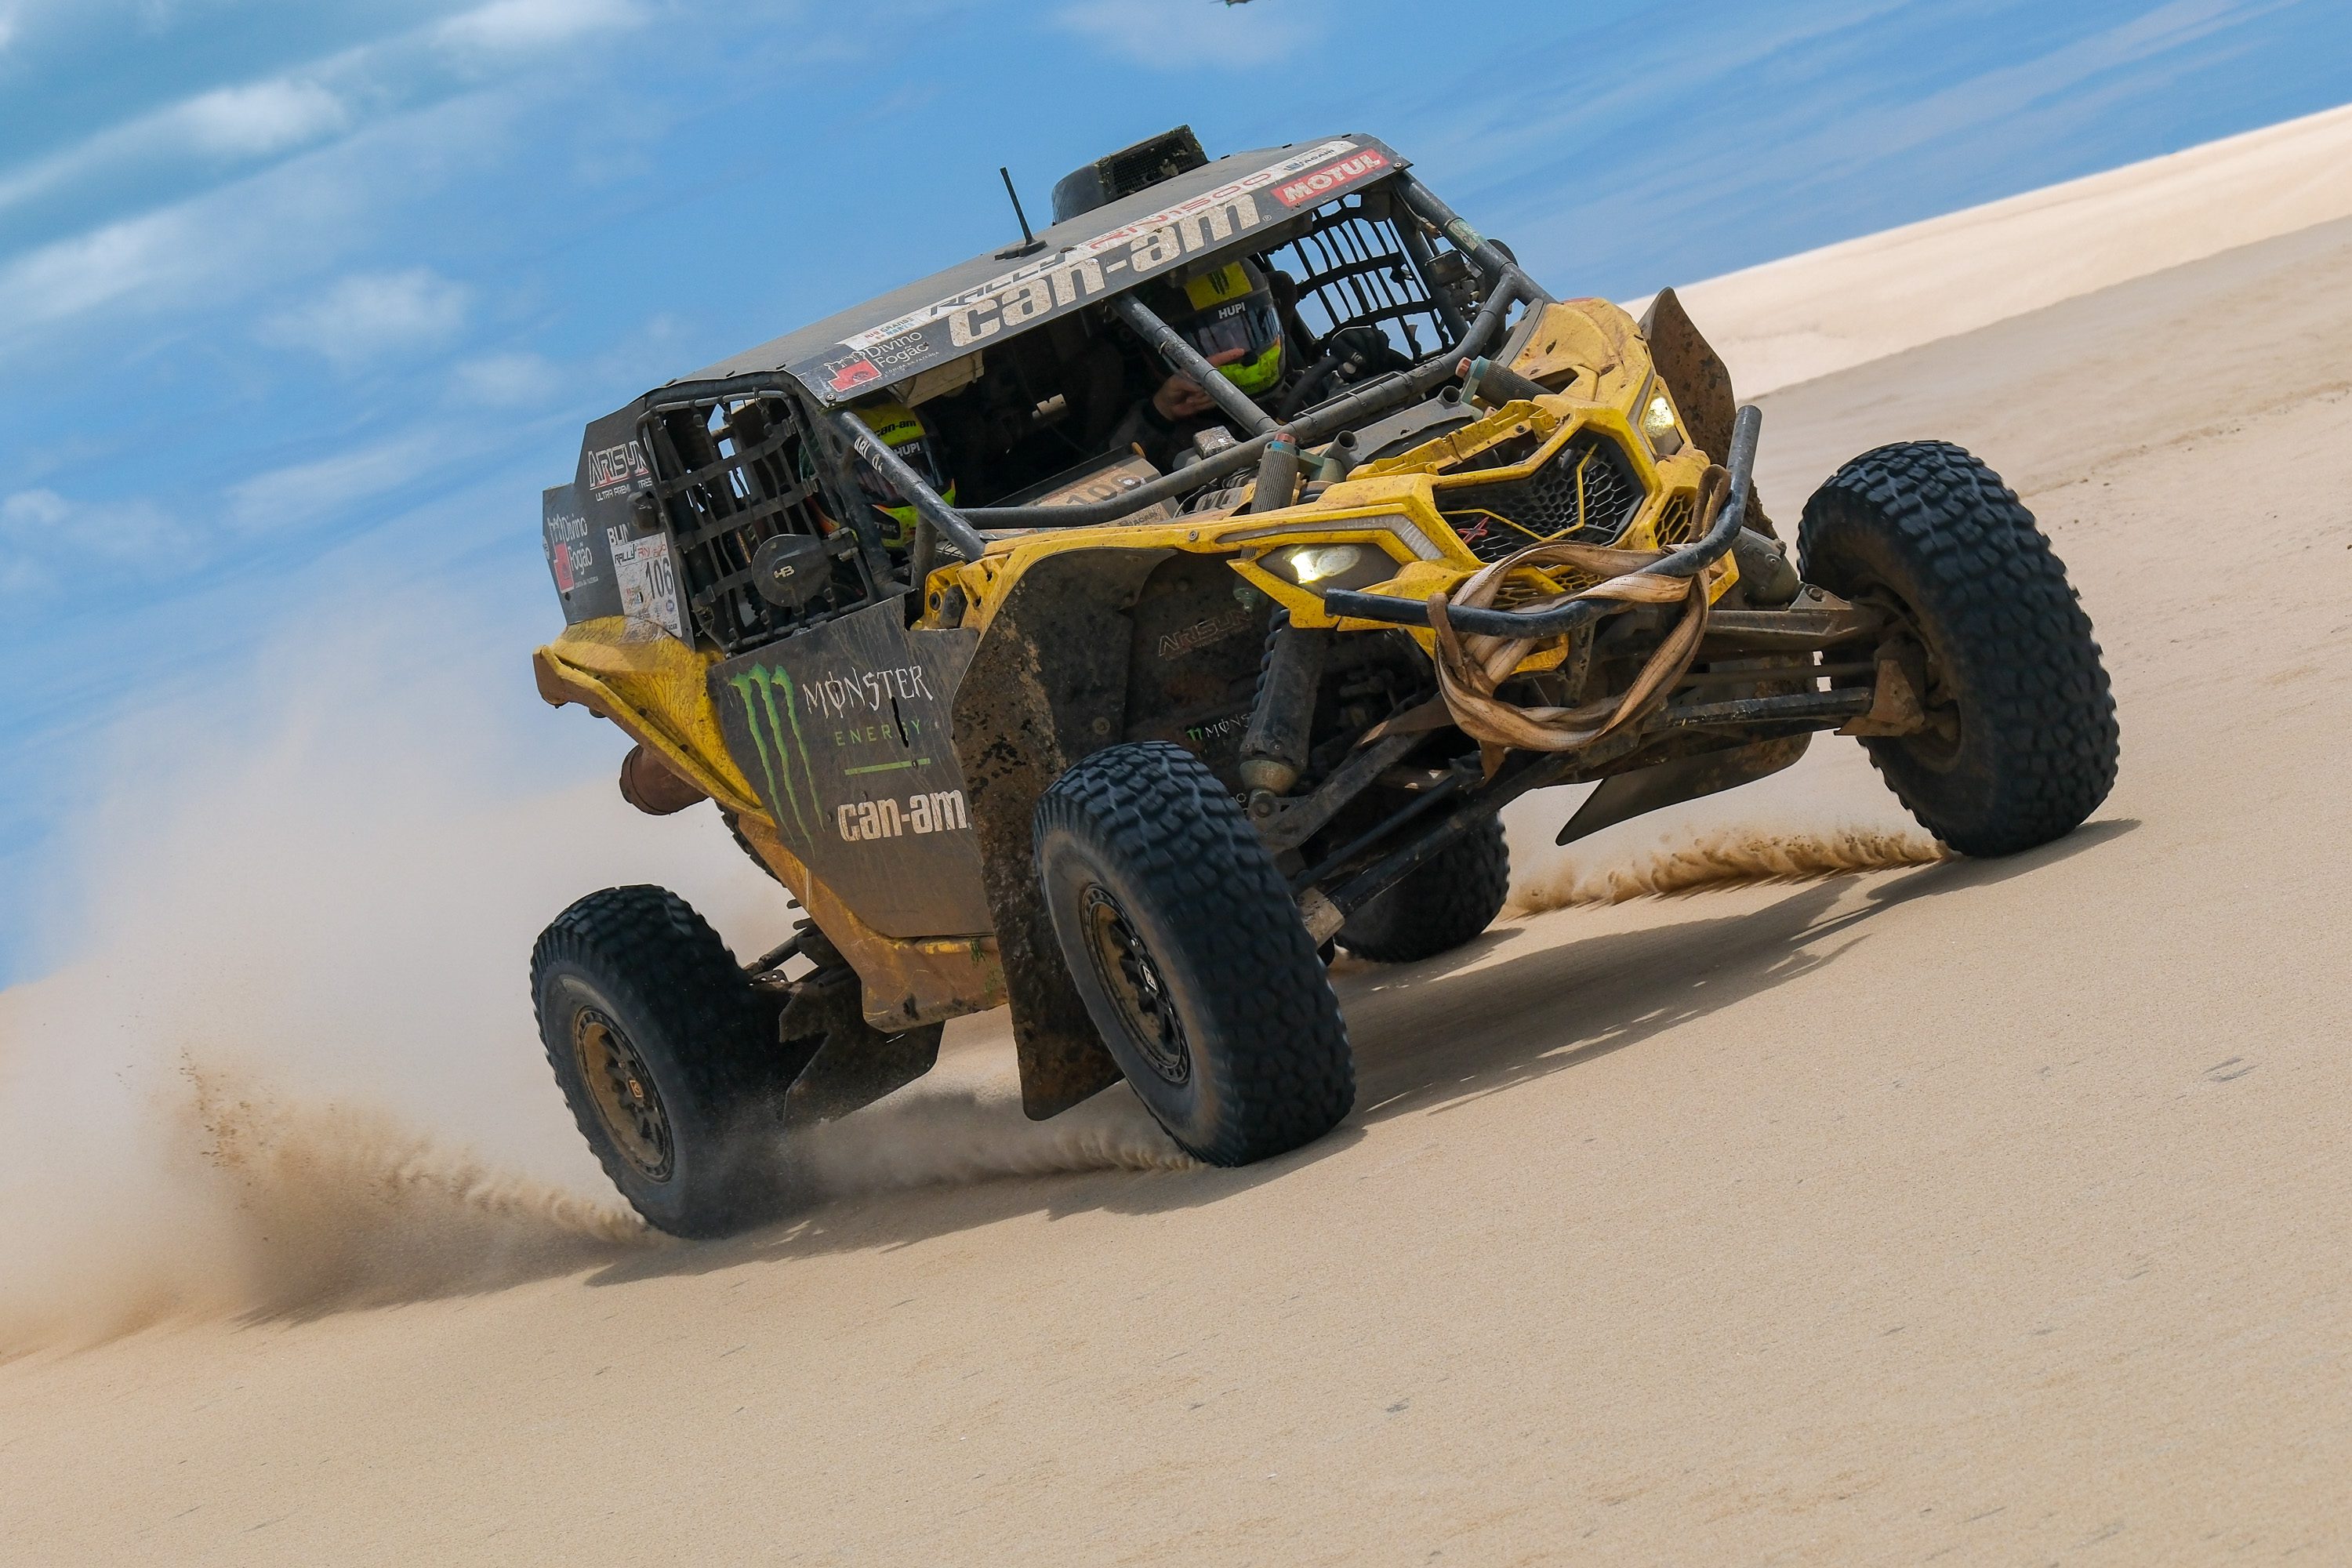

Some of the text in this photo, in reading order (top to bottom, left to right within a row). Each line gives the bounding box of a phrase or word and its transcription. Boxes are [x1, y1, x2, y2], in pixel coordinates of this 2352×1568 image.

[1283, 154, 1381, 203] MOTUL
[949, 193, 1261, 347] can-am
[1218, 302, 1246, 319] HUPI
[866, 332, 923, 358] Divino
[873, 341, 929, 368] Fogão
[588, 437, 650, 488] ARISUN
[893, 441, 920, 457] HUPI
[596, 489, 613, 502] ULTRA
[637, 477, 654, 490] TIRES
[561, 513, 588, 542] Divino
[568, 541, 593, 575] Fogão
[645, 557, 673, 599] 106
[837, 789, 967, 842] can-am
